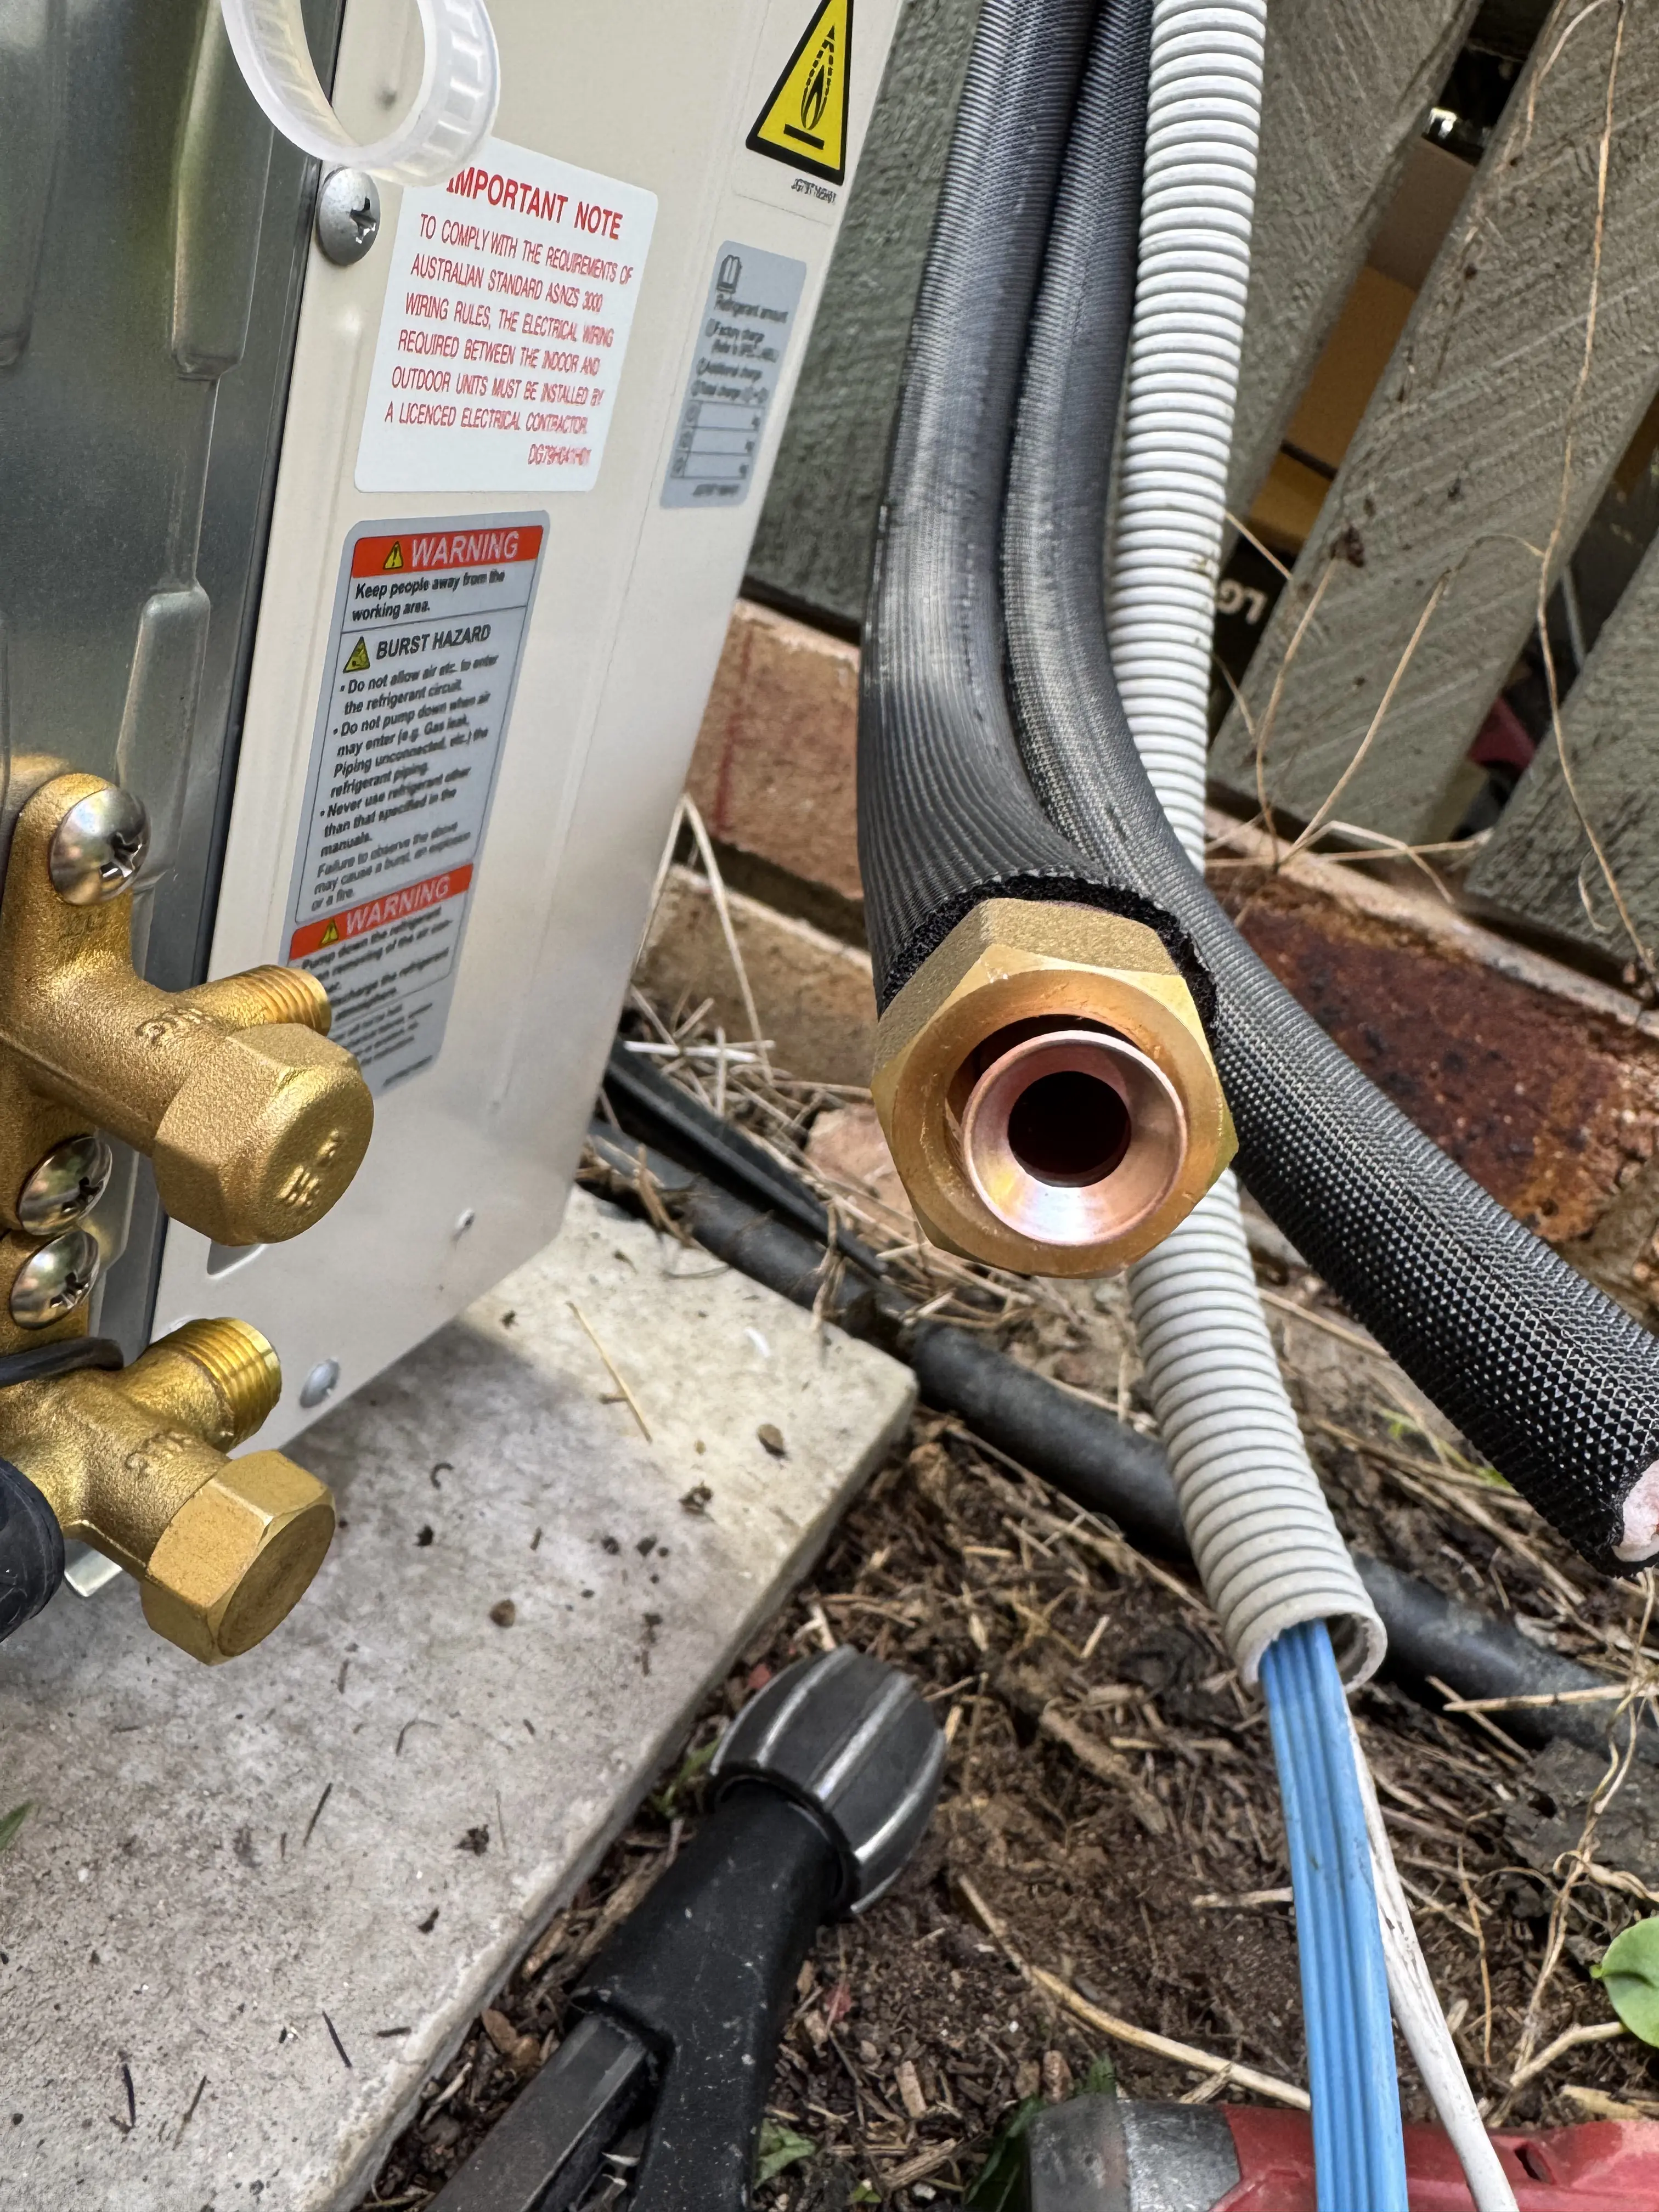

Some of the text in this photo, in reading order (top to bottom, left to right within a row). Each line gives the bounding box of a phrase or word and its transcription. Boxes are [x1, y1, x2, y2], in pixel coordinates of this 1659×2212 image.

[445, 166, 623, 240] IMPORTANT NOTE
[420, 213, 633, 285] TO COMPLY WITH THE REQUIREMENTS OF
[411, 255, 484, 287] AUSTRALIAN
[488, 270, 543, 300] STANDARD
[405, 293, 613, 347] WIRING RULES, THE ELECTRICAL WIRING
[398, 330, 600, 376] REQUIRED BETWEEN THE INDOOR AND
[392, 366, 603, 407] OUTDOOR UNITS MUST BE INSTALLED BY
[385, 401, 587, 433] A LICENCED ELECTRICAL CONTRACTOR
[413, 532, 518, 566] WARNING
[354, 568, 505, 601] Keep people away from the
[351, 602, 401, 622] working
[376, 624, 491, 660] BURST HAZARD
[347, 679, 365, 695] Do
[367, 674, 388, 691] not
[390, 670, 421, 687] allow
[422, 664, 438, 680] air
[472, 654, 499, 670] enter
[344, 700, 364, 715] the
[365, 686, 427, 710] refrigerant
[340, 721, 358, 737] Do
[360, 715, 381, 732] not
[382, 710, 415, 731] pump
[417, 702, 447, 719] down
[336, 741, 364, 758] may
[365, 733, 396, 751] enter
[330, 770, 392, 798] refrigerant
[334, 758, 373, 779] Piping
[326, 798, 363, 819] Never
[364, 792, 386, 808] use
[324, 821, 351, 838] than
[353, 810, 376, 829] that
[314, 877, 339, 895] may
[340, 865, 373, 889] cause
[317, 856, 356, 878] Failure
[357, 852, 369, 865] to
[347, 877, 448, 933] WARNING
